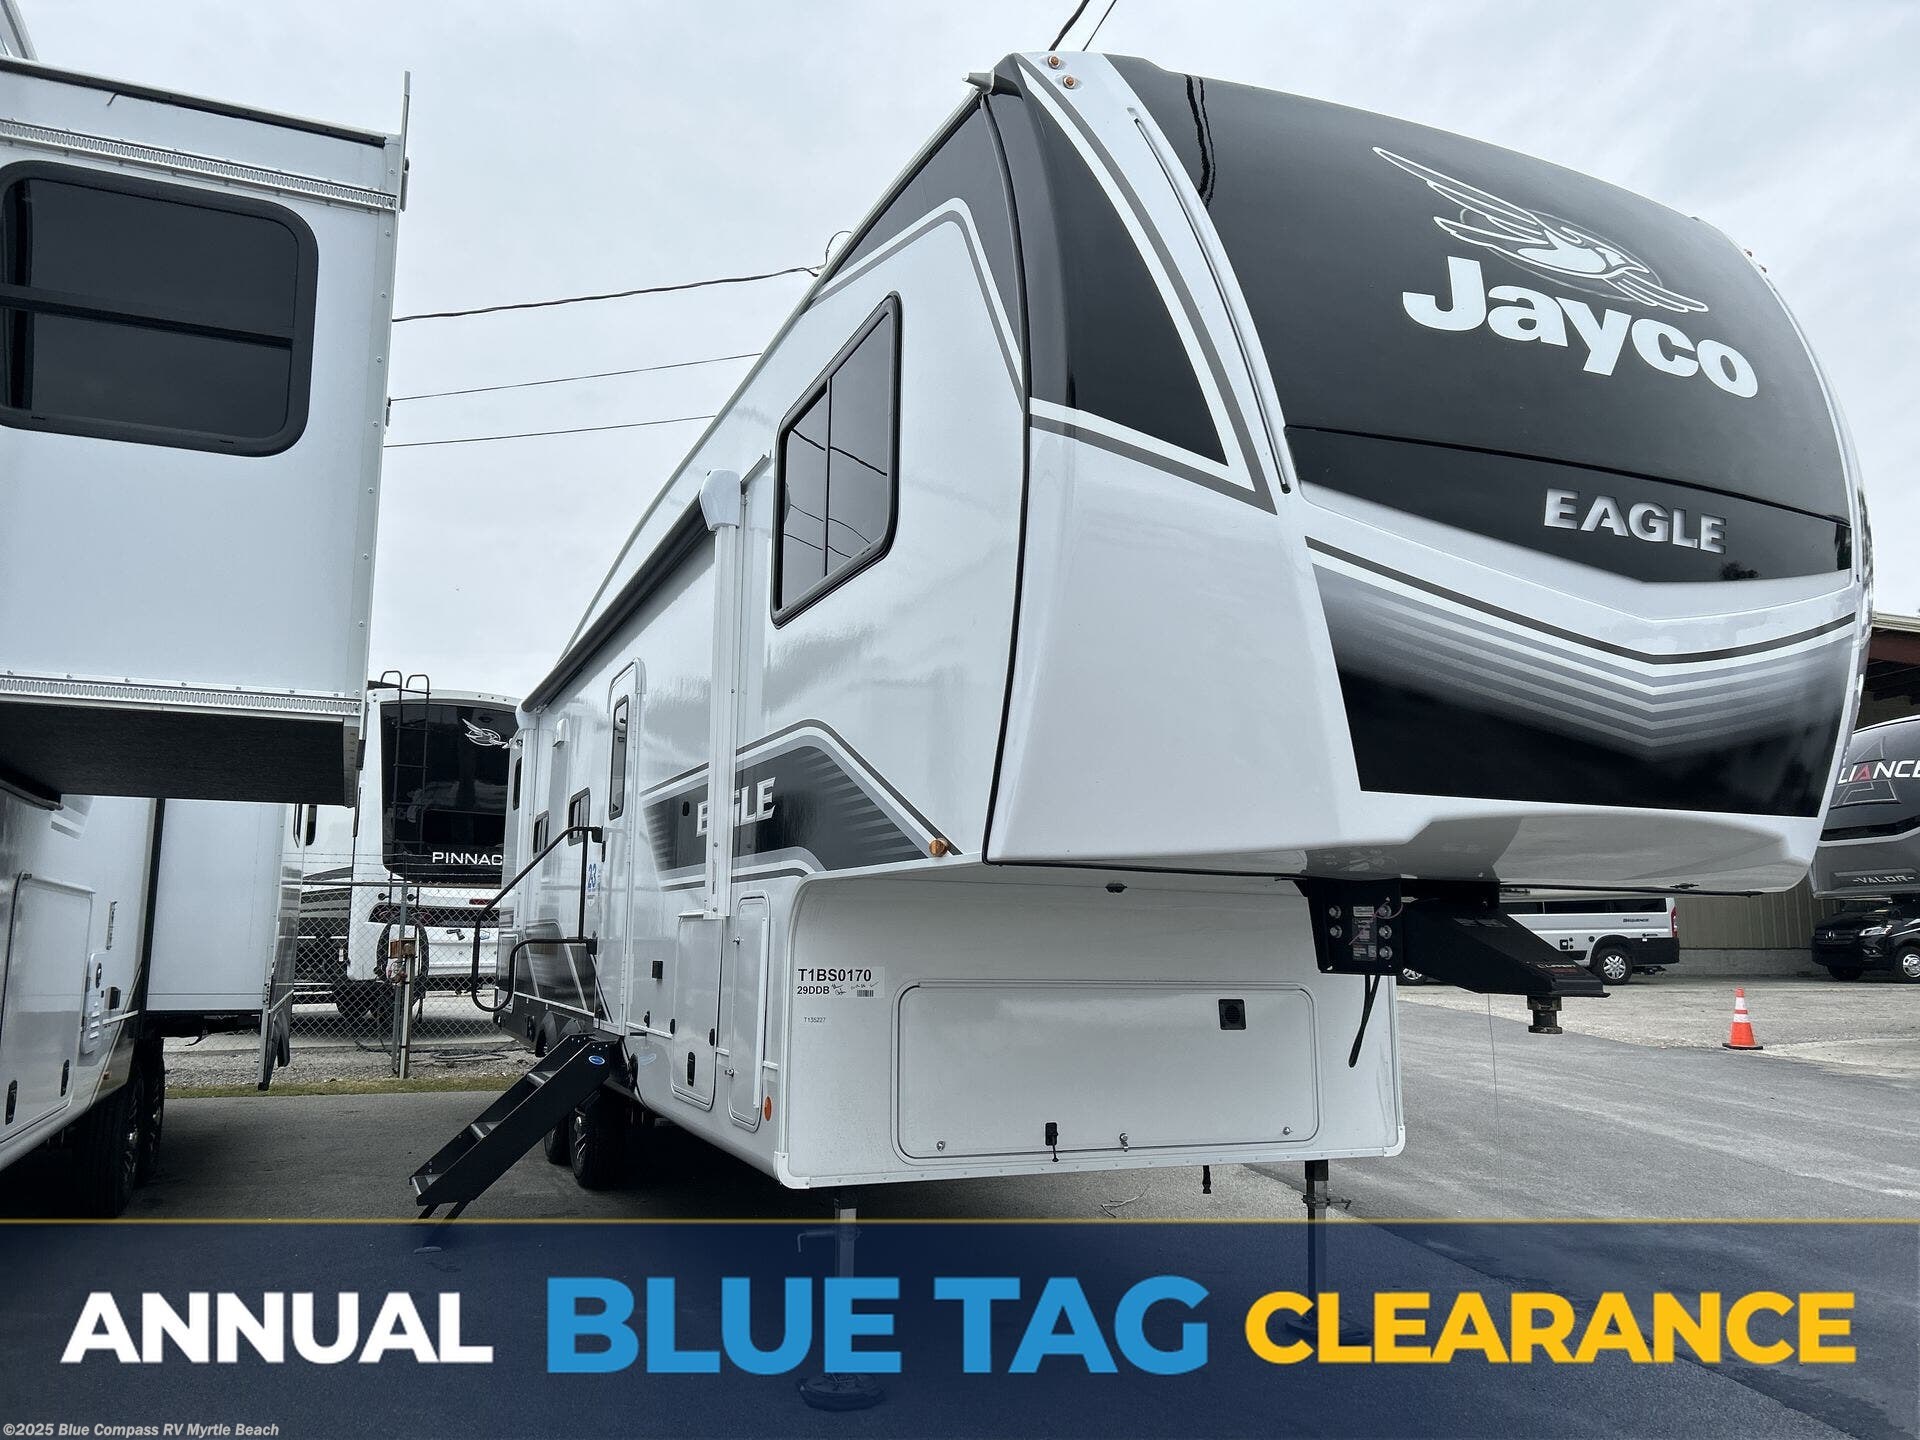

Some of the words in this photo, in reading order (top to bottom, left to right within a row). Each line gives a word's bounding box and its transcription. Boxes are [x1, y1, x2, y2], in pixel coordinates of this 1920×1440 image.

[1403, 256, 1758, 398] Jayco
[1543, 489, 1727, 554] EAGLE
[696, 777, 776, 838] ELE
[797, 985, 830, 995] 29DDB
[798, 968, 872, 982] T1BS0170
